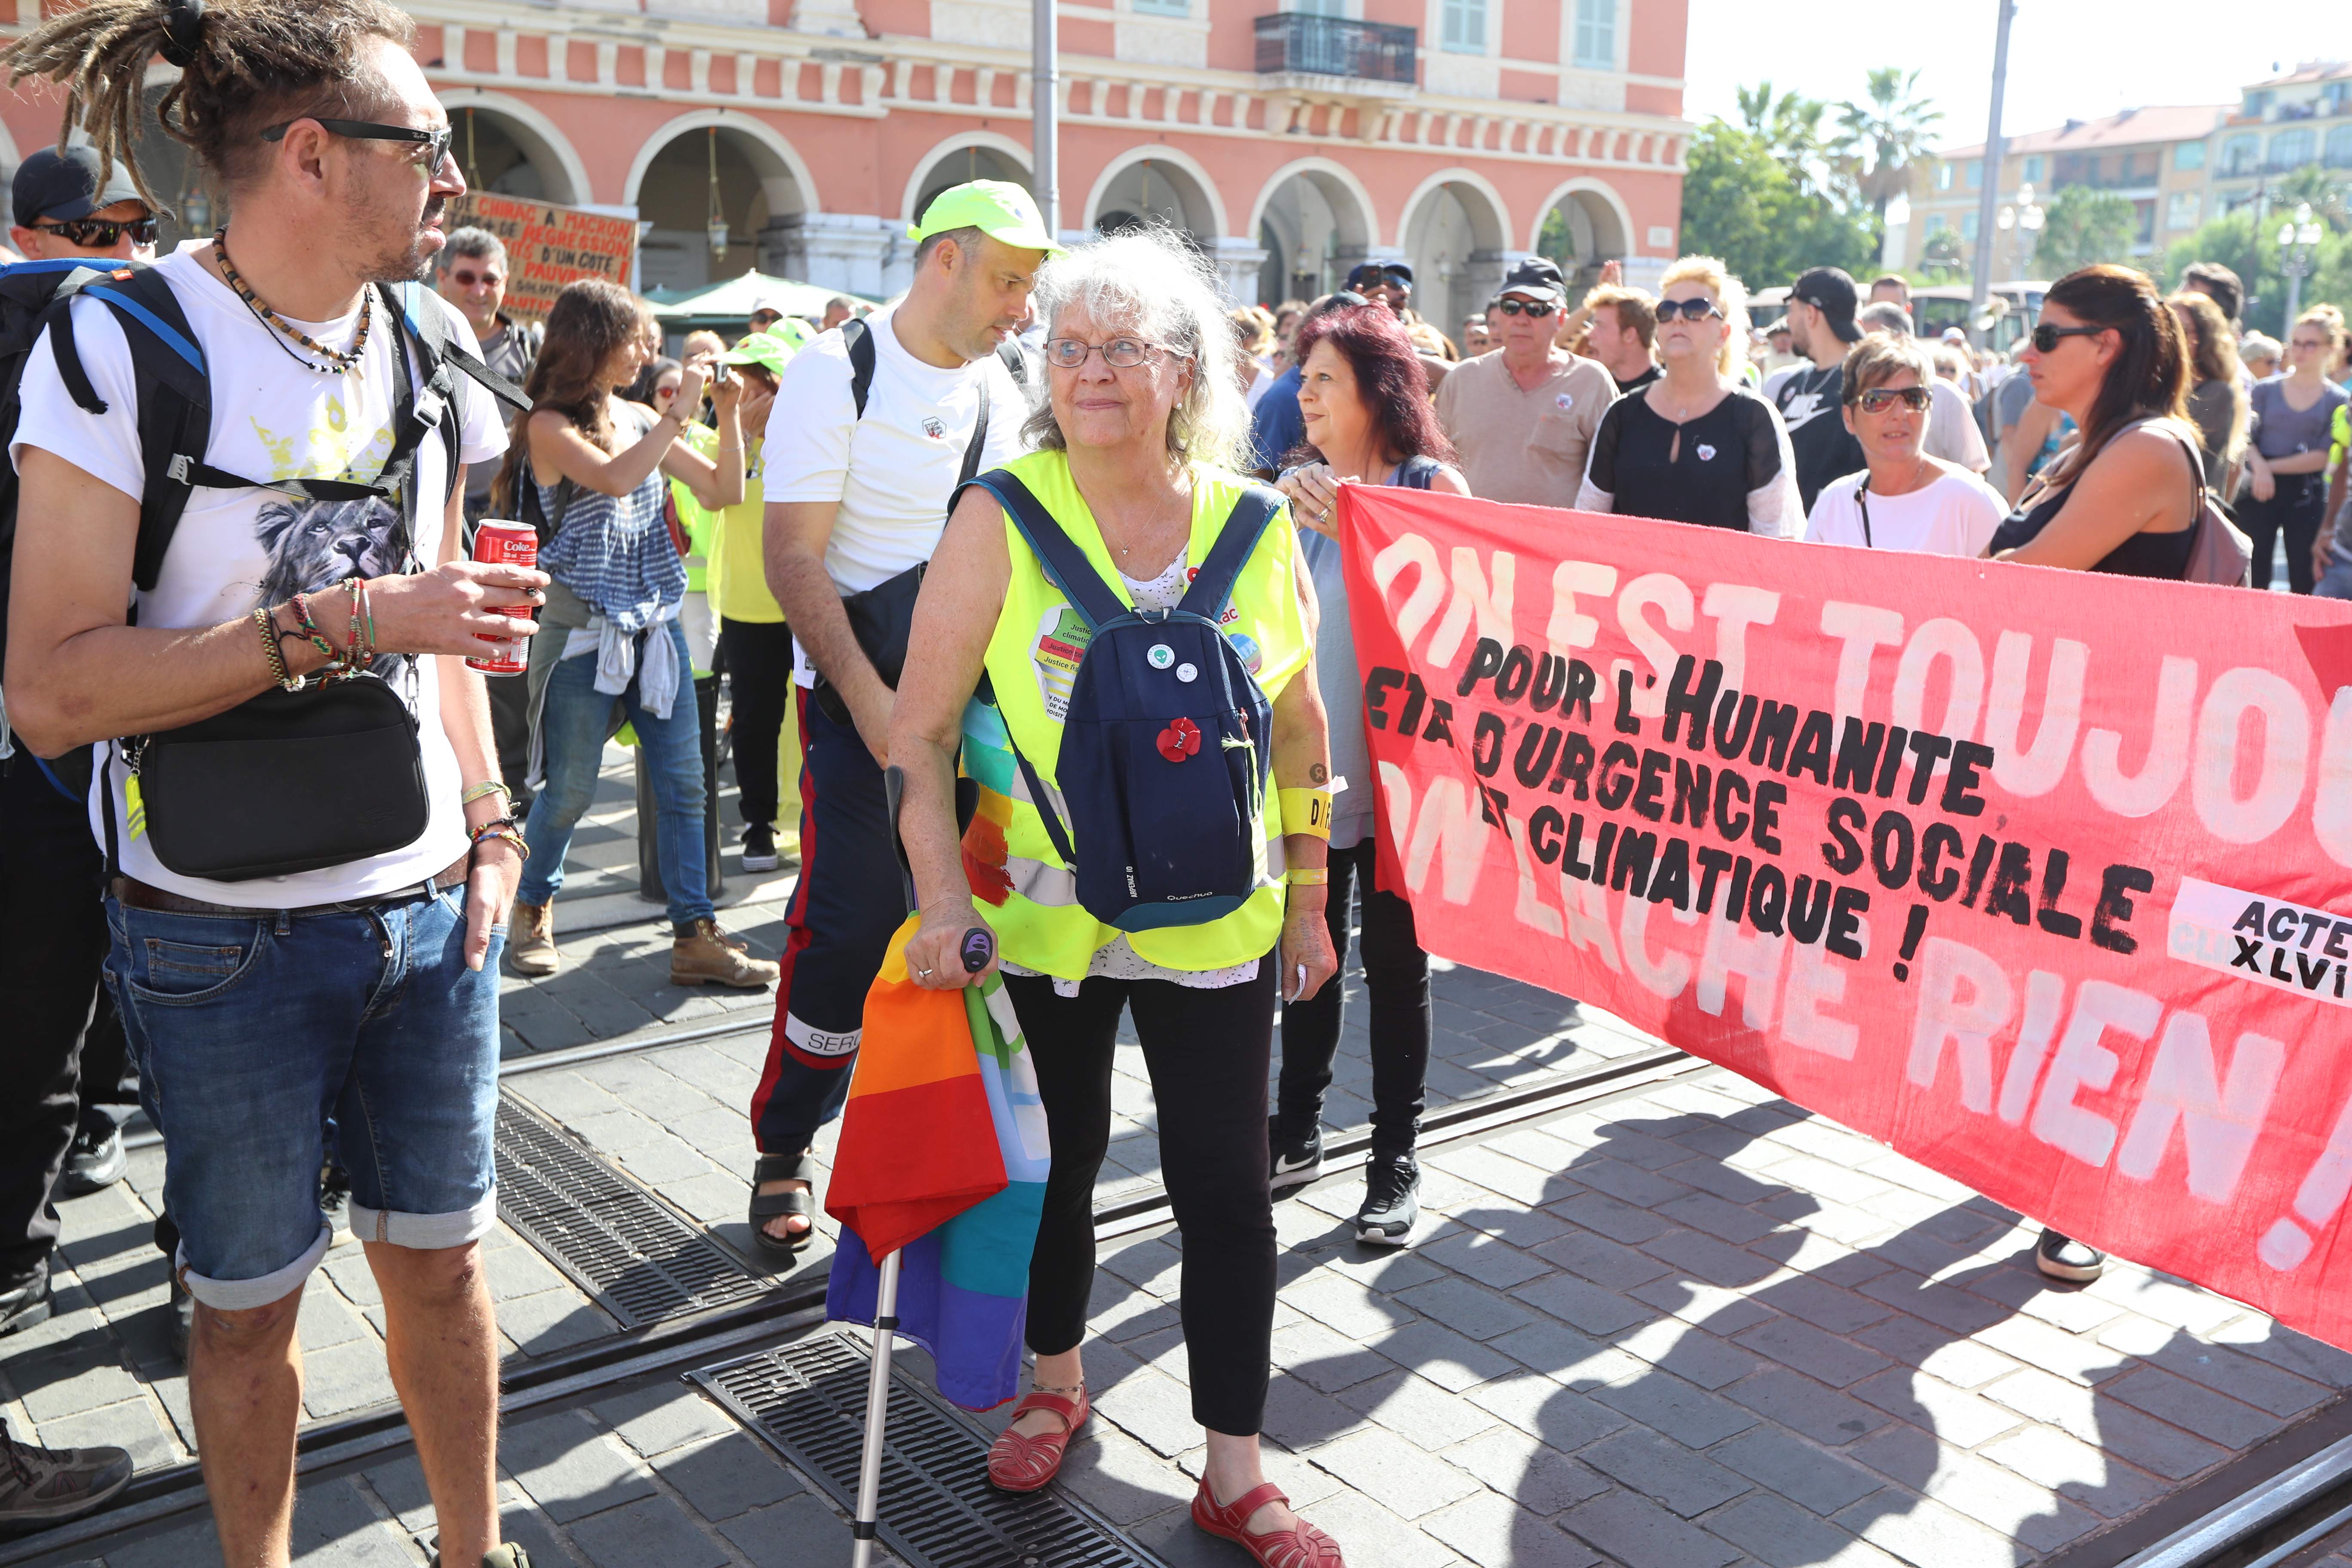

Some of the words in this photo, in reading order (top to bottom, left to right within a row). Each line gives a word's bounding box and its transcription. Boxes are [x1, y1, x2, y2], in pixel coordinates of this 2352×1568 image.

[454, 196, 472, 211] DE
[478, 197, 537, 223] CHIRAC
[545, 211, 555, 226] A
[521, 224, 630, 258] REGRESSION
[504, 541, 530, 551] Coke
[1372, 532, 1515, 669] ON
[1543, 560, 1781, 726] EST
[1044, 656, 1069, 669] Justice
[1048, 643, 1072, 655] Justice
[1457, 637, 1596, 726] POUR
[1472, 711, 1787, 855] D'URGENCE
[1821, 797, 2154, 955] SOCIALE
[1127, 874, 1138, 898] ARPENAZ
[1167, 891, 1213, 901] Quechua
[1528, 805, 1870, 960] CLIMATIQUE
[1893, 904, 1929, 983] !
[2233, 901, 2352, 960] ACTE
[1906, 936, 2286, 1205] RIEN
